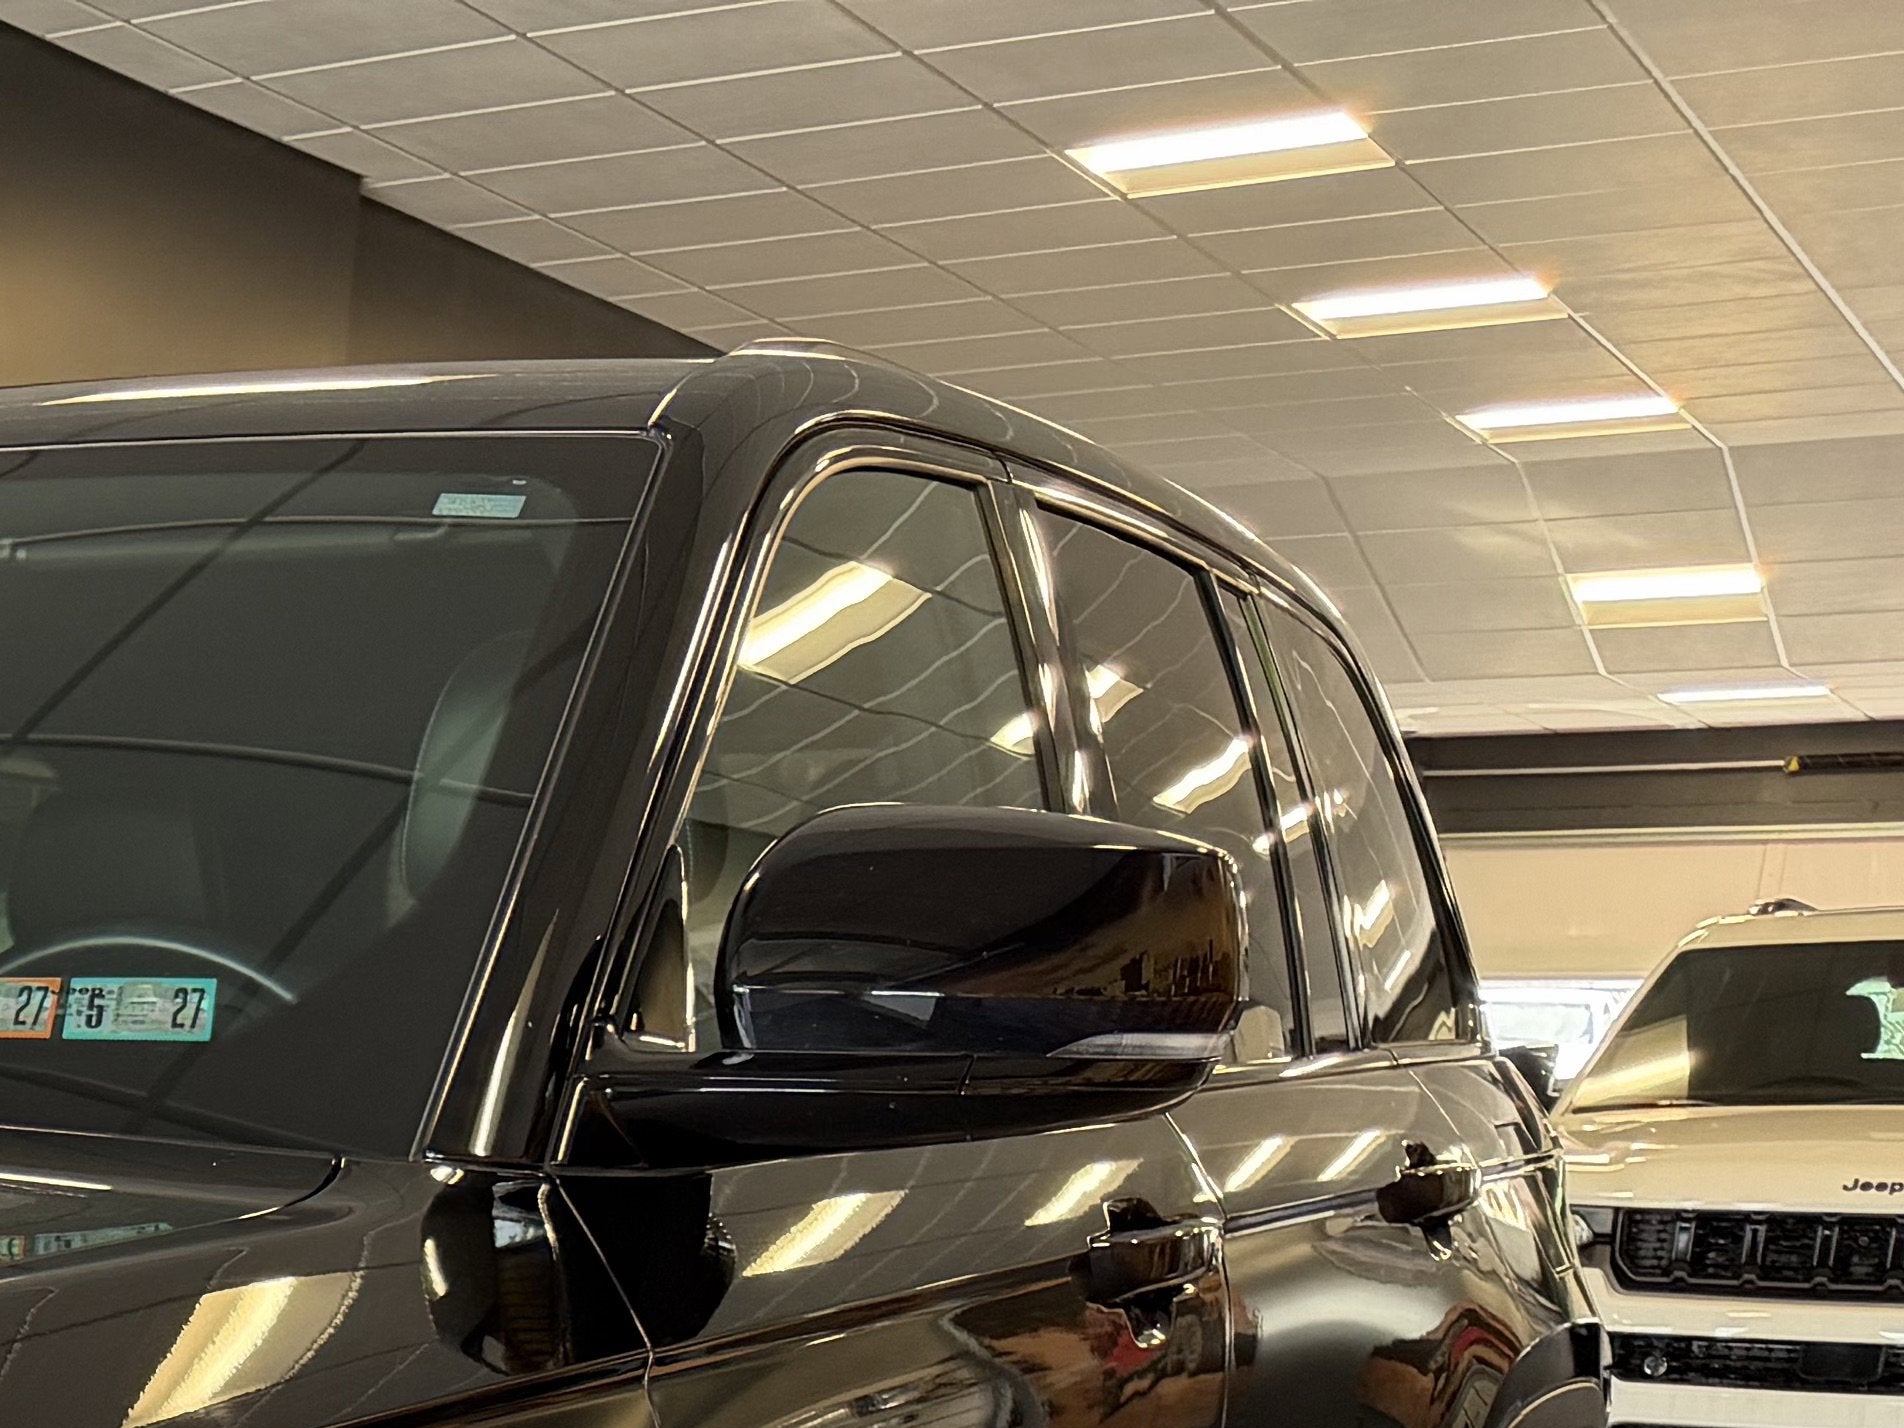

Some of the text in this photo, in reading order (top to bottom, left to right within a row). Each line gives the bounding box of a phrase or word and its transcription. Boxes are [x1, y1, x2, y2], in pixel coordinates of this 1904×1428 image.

[13, 985, 50, 1028] 27
[84, 987, 206, 1029] 5 27
[1841, 1178, 1904, 1196] Jeep
